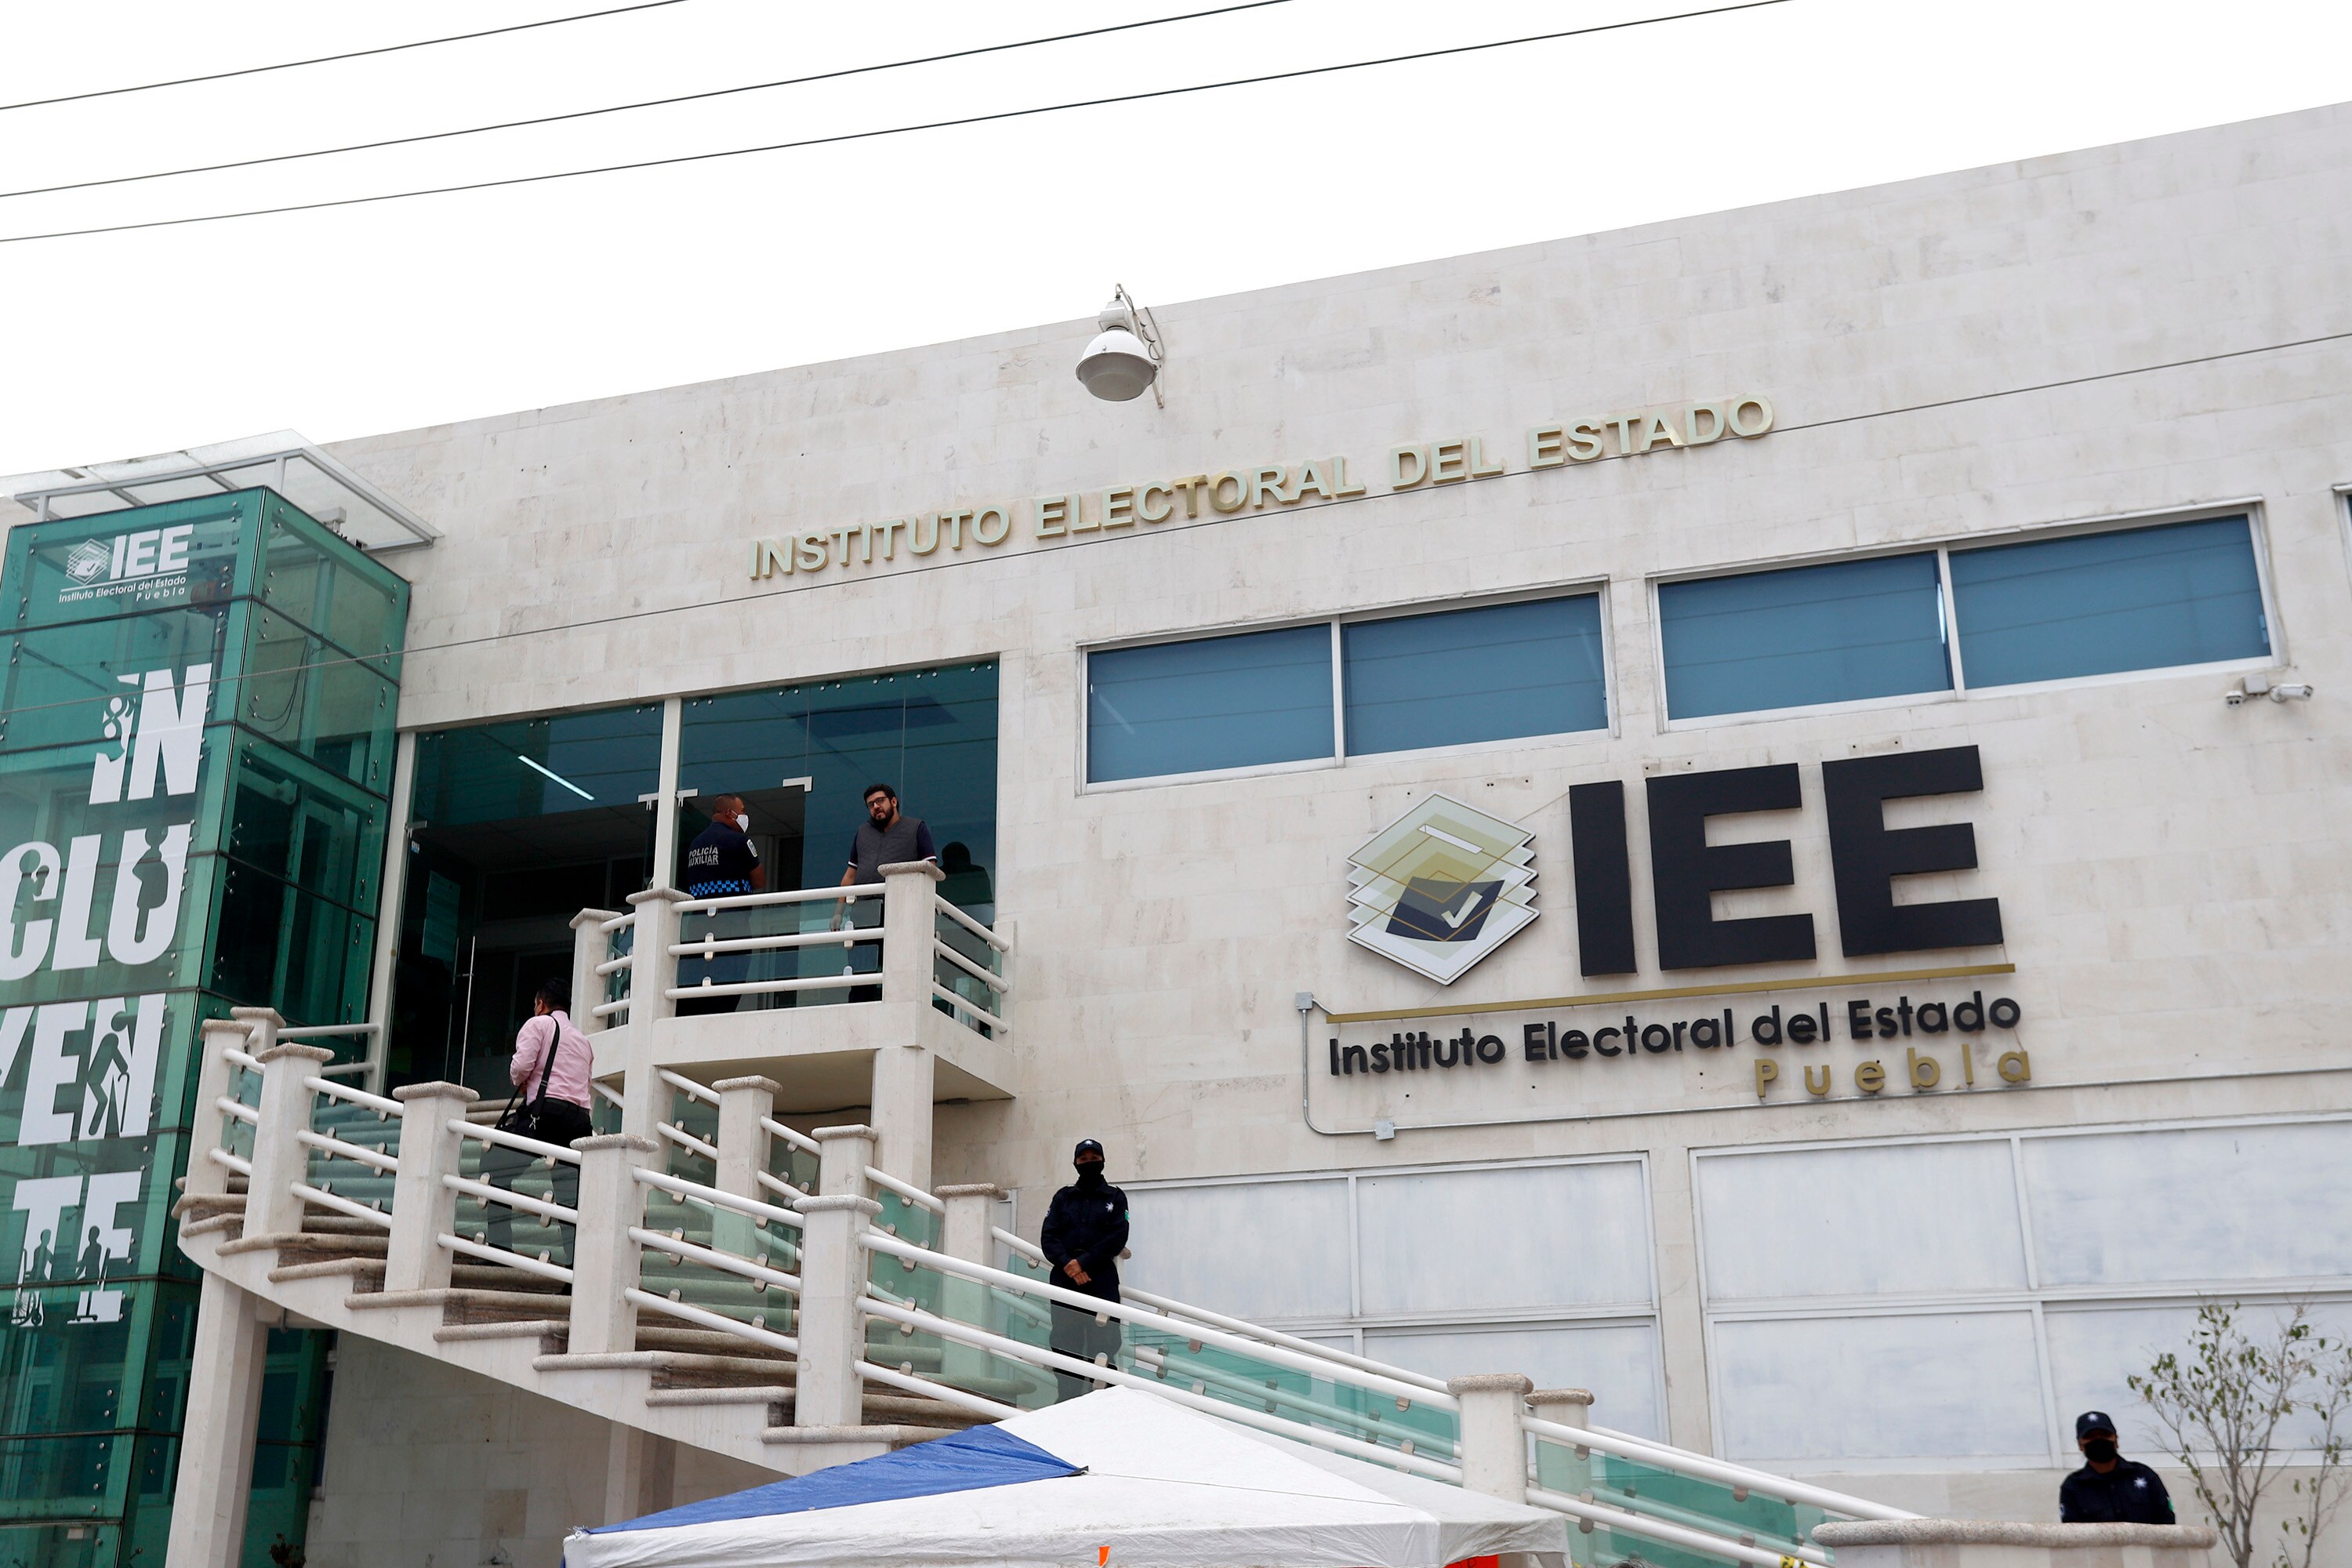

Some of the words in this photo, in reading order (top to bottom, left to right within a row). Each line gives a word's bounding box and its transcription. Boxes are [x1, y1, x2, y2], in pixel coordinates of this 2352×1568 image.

[748, 503, 1011, 580] INSTITUTO
[1034, 455, 1367, 539] ELECTORAL
[1389, 435, 1504, 492] DEL
[1528, 394, 1774, 470] ESTADO
[109, 524, 194, 580] IEE
[59, 590, 93, 603] Instituto
[96, 584, 136, 597] Electoral
[138, 581, 154, 591] del
[155, 575, 187, 588] Estado
[136, 586, 186, 602] Puebla
[689, 844, 719, 858] POLICÍA
[1569, 745, 2004, 977] IEE
[1330, 1028, 1505, 1076] Instituto
[1524, 1007, 1734, 1062] Electoral
[1751, 1002, 1831, 1046] del
[1848, 990, 2021, 1040] Estado
[1754, 1044, 2031, 1098] Puebla
